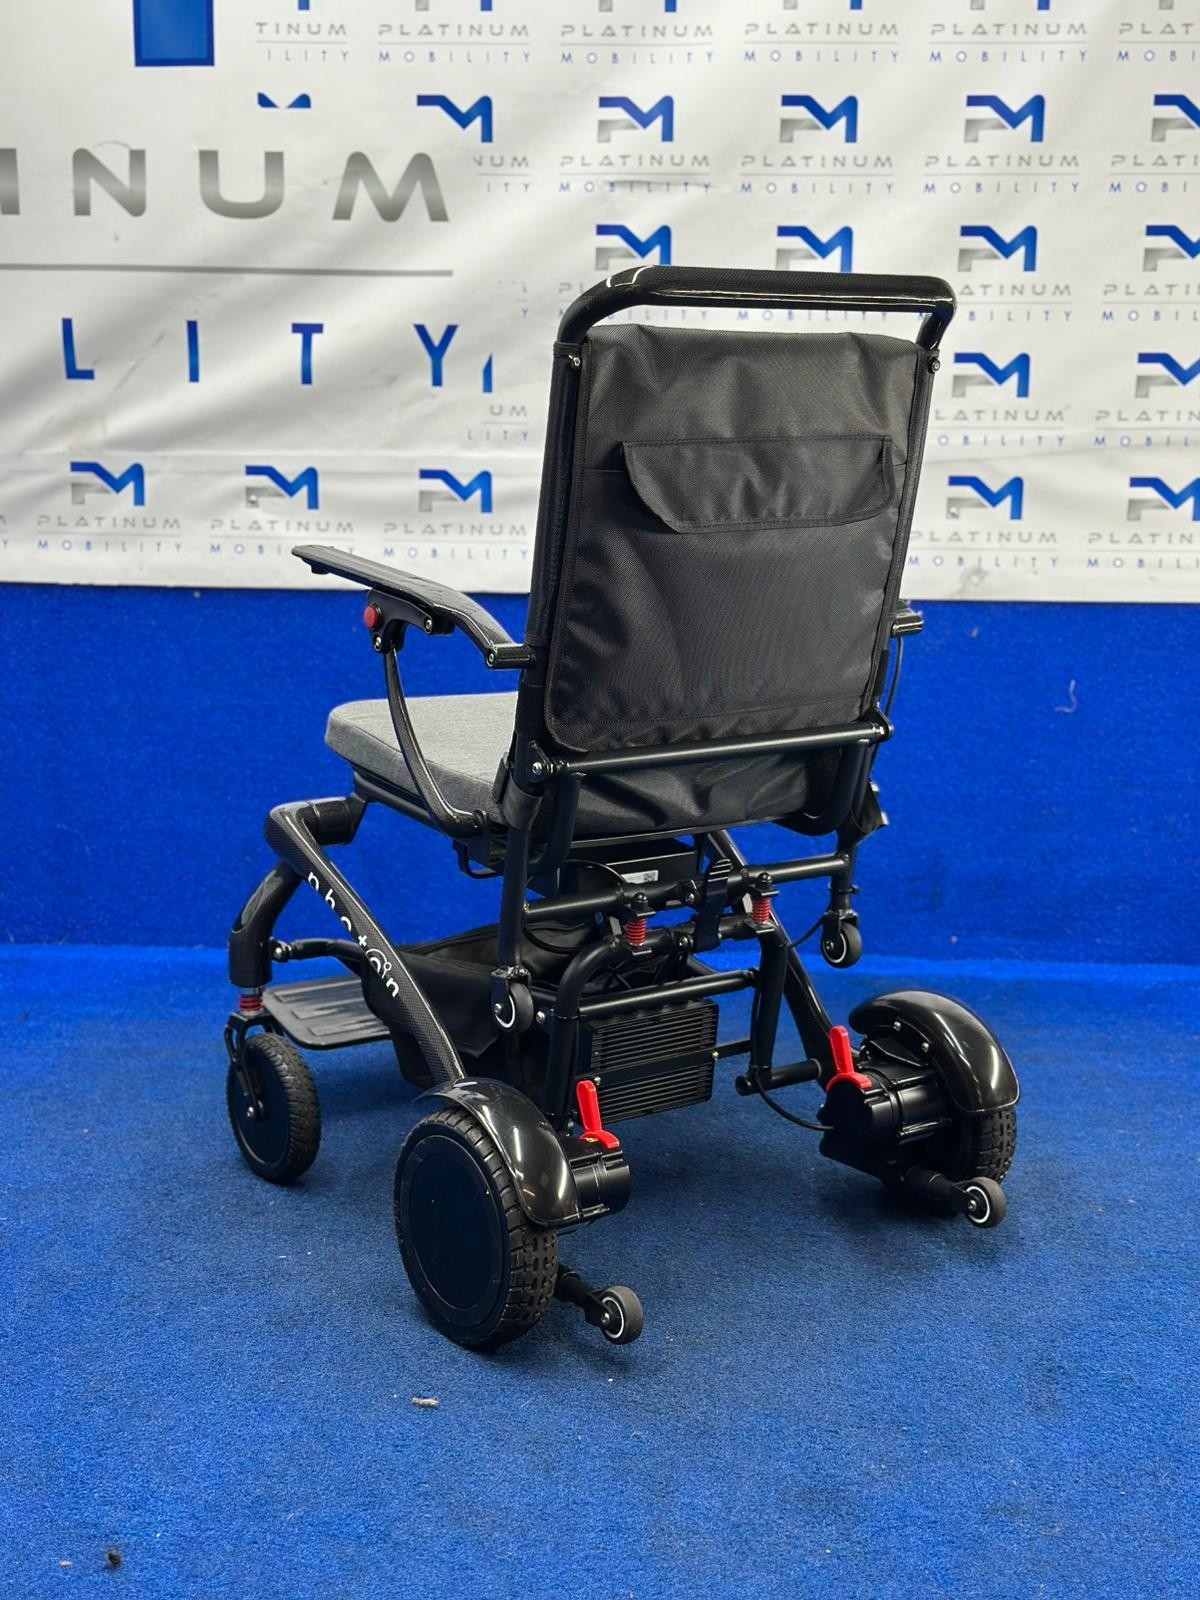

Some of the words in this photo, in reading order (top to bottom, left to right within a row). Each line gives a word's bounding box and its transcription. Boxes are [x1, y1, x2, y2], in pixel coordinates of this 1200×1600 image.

[378, 24, 529, 36] PLATINUM
[561, 25, 712, 37] PLATINUM
[745, 22, 898, 35] PLATINUM
[931, 23, 1086, 35] PLATINUM
[378, 50, 531, 63] MOBILITY
[560, 51, 714, 64] MOBILITY
[744, 49, 899, 64] MOBILITY
[929, 50, 1088, 64] MOBILITY
[559, 154, 711, 169] PLATINUM
[741, 155, 893, 168] PLATINUM
[925, 155, 1079, 167] PLATINUM
[740, 182, 894, 194] MOBILITY
[923, 182, 1079, 194] MOBILITY
[959, 284, 1071, 296] ATINUM
[935, 409, 1064, 421] LATINUM
[936, 434, 1066, 448] OBILITY
[37, 515, 182, 530] PLATINUM
[210, 519, 355, 534] PLATINUM
[384, 523, 527, 537] PLATINUM
[909, 530, 1058, 544] PLATINUM
[37, 539, 182, 552] MOBILITY
[383, 547, 529, 560] MOBILITY
[907, 555, 1059, 568] MOBILITY
